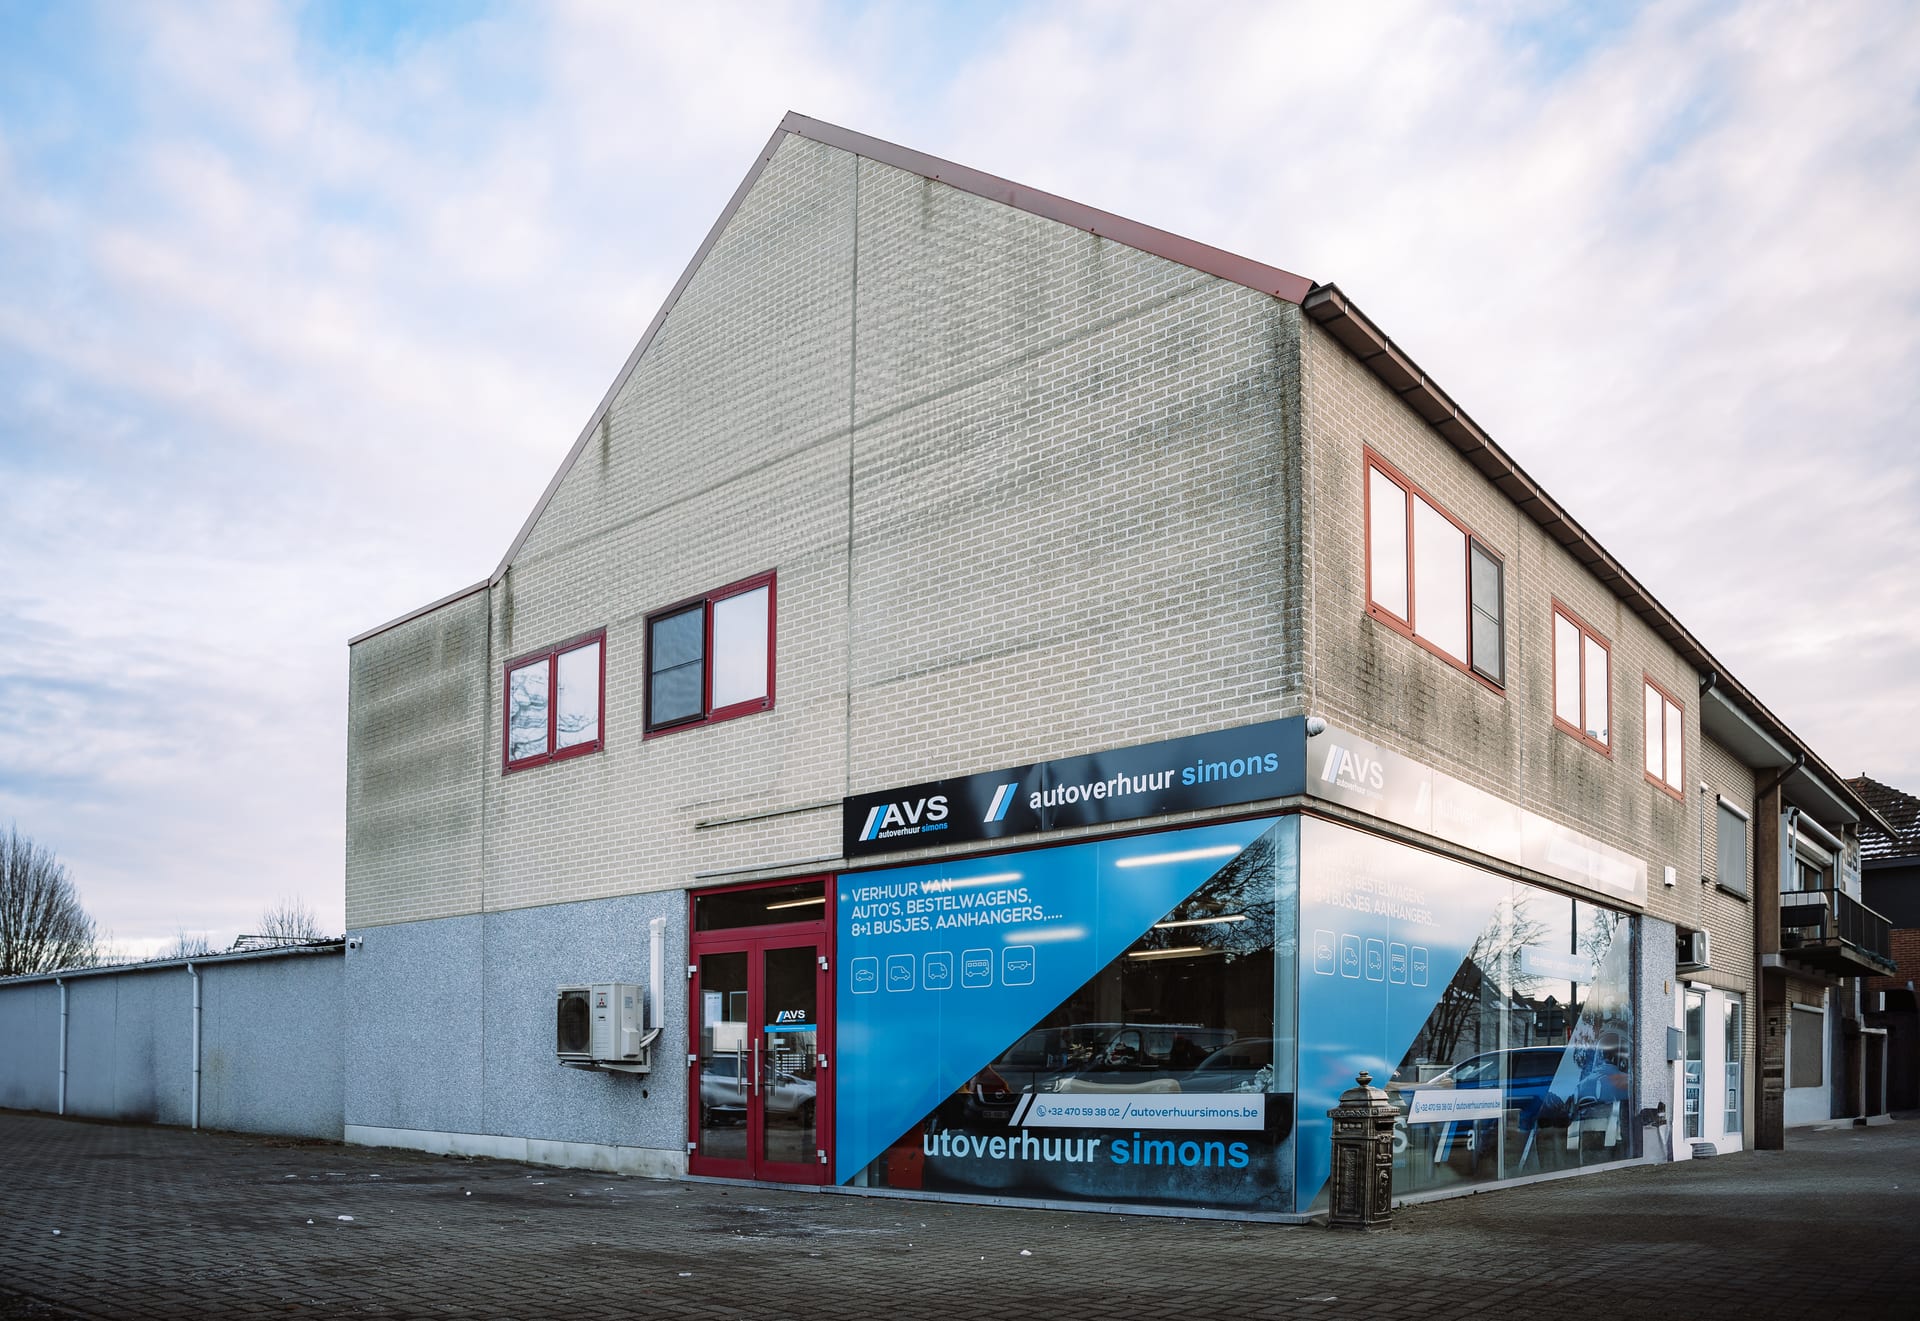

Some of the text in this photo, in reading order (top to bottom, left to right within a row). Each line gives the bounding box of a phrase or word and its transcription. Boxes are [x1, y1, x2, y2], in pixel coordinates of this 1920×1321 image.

[1029, 752, 1279, 809] autoverhuur simons
[1338, 750, 1384, 789] AVS
[880, 795, 949, 829] AVS
[878, 822, 948, 839] autoverhuur simons
[851, 878, 952, 902] VERHUUR VAN
[851, 887, 1032, 920] AUTO'S, BESTELWAGENS,
[851, 922, 872, 937] 8+1
[873, 916, 933, 935] BUSJES,
[783, 1009, 806, 1019] AVS
[1048, 1107, 1063, 1116] +32
[1064, 1107, 1081, 1116] 470
[1081, 1107, 1094, 1116] 59
[1094, 1107, 1107, 1117] 38
[1108, 1107, 1120, 1117] 02
[1130, 1107, 1258, 1118] autoverhuursimons.be
[923, 1128, 1249, 1168] utoverhuur simons
